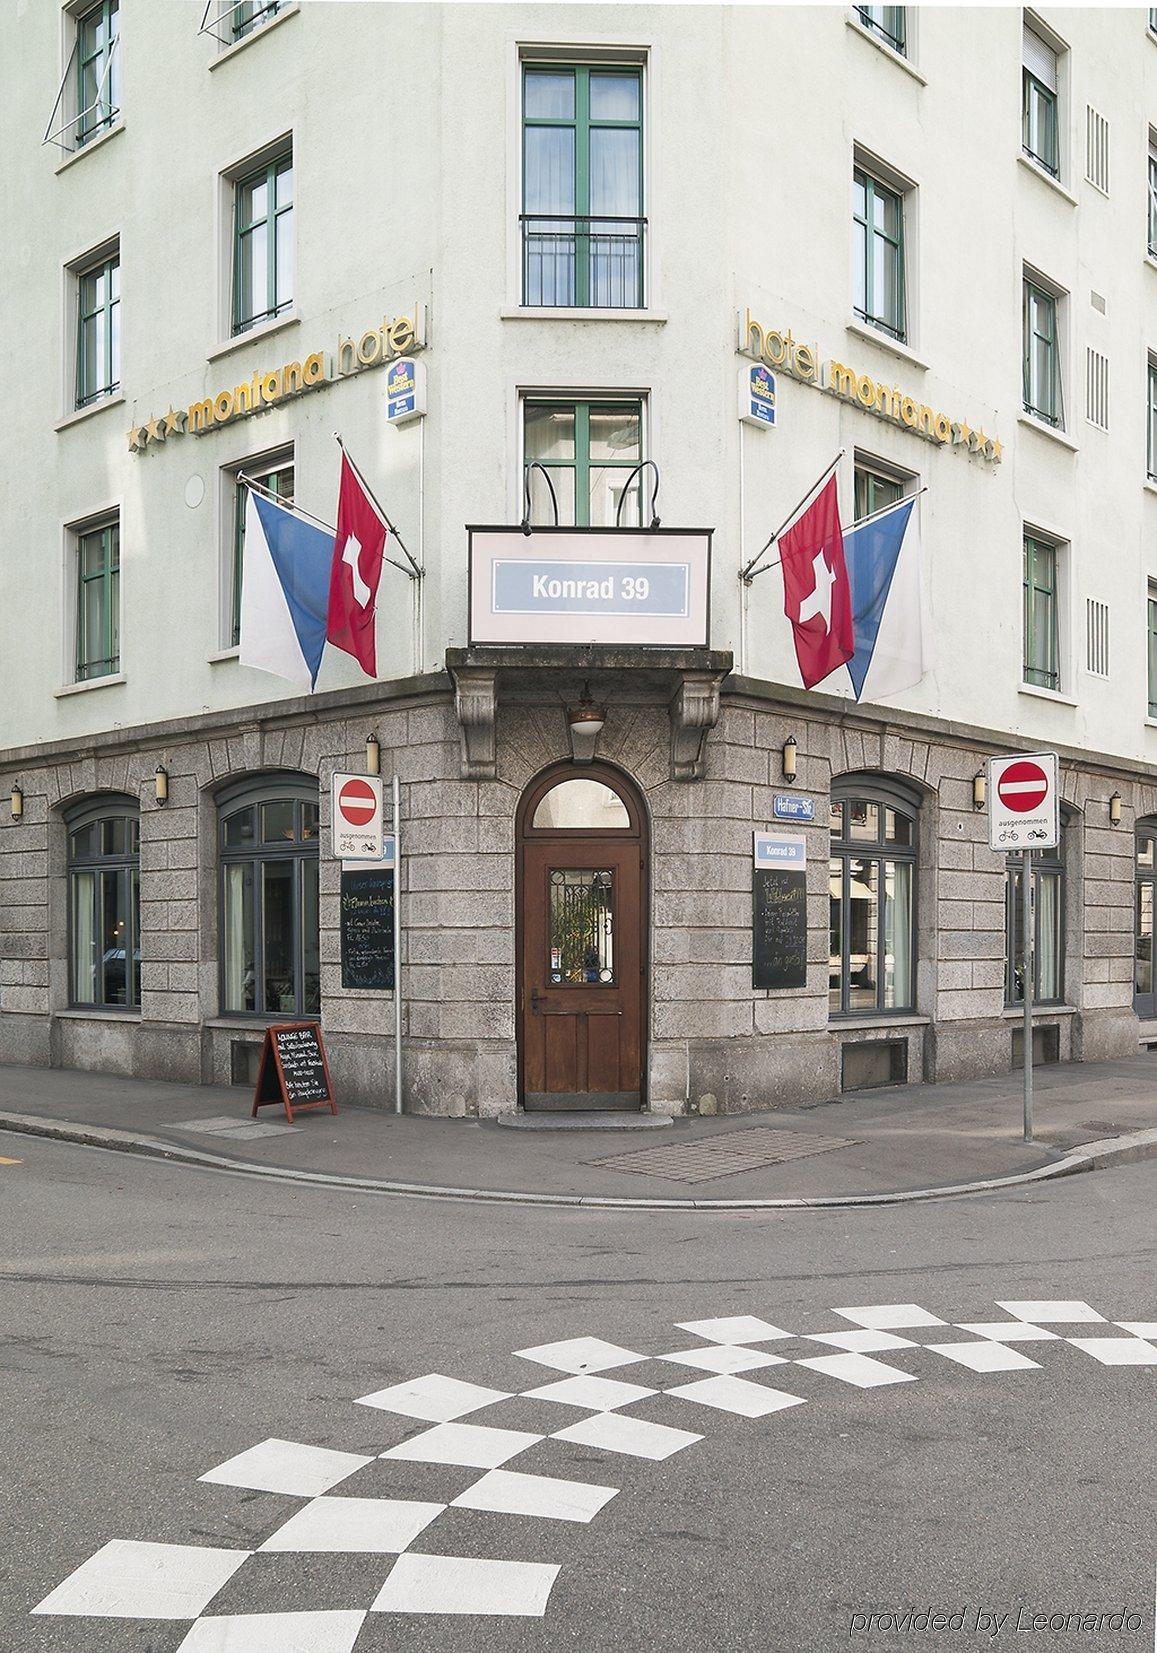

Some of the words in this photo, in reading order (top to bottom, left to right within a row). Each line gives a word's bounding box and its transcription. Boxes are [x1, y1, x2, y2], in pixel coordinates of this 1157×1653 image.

[188, 350, 328, 435] montana
[337, 301, 424, 376] hotel
[744, 307, 821, 384] hotel
[829, 358, 952, 443] montana
[532, 574, 614, 600] Konrad
[621, 577, 649, 600] 39
[998, 818, 1048, 828] ausgenommen
[766, 846, 788, 856] Konrad
[788, 847, 796, 857] 39
